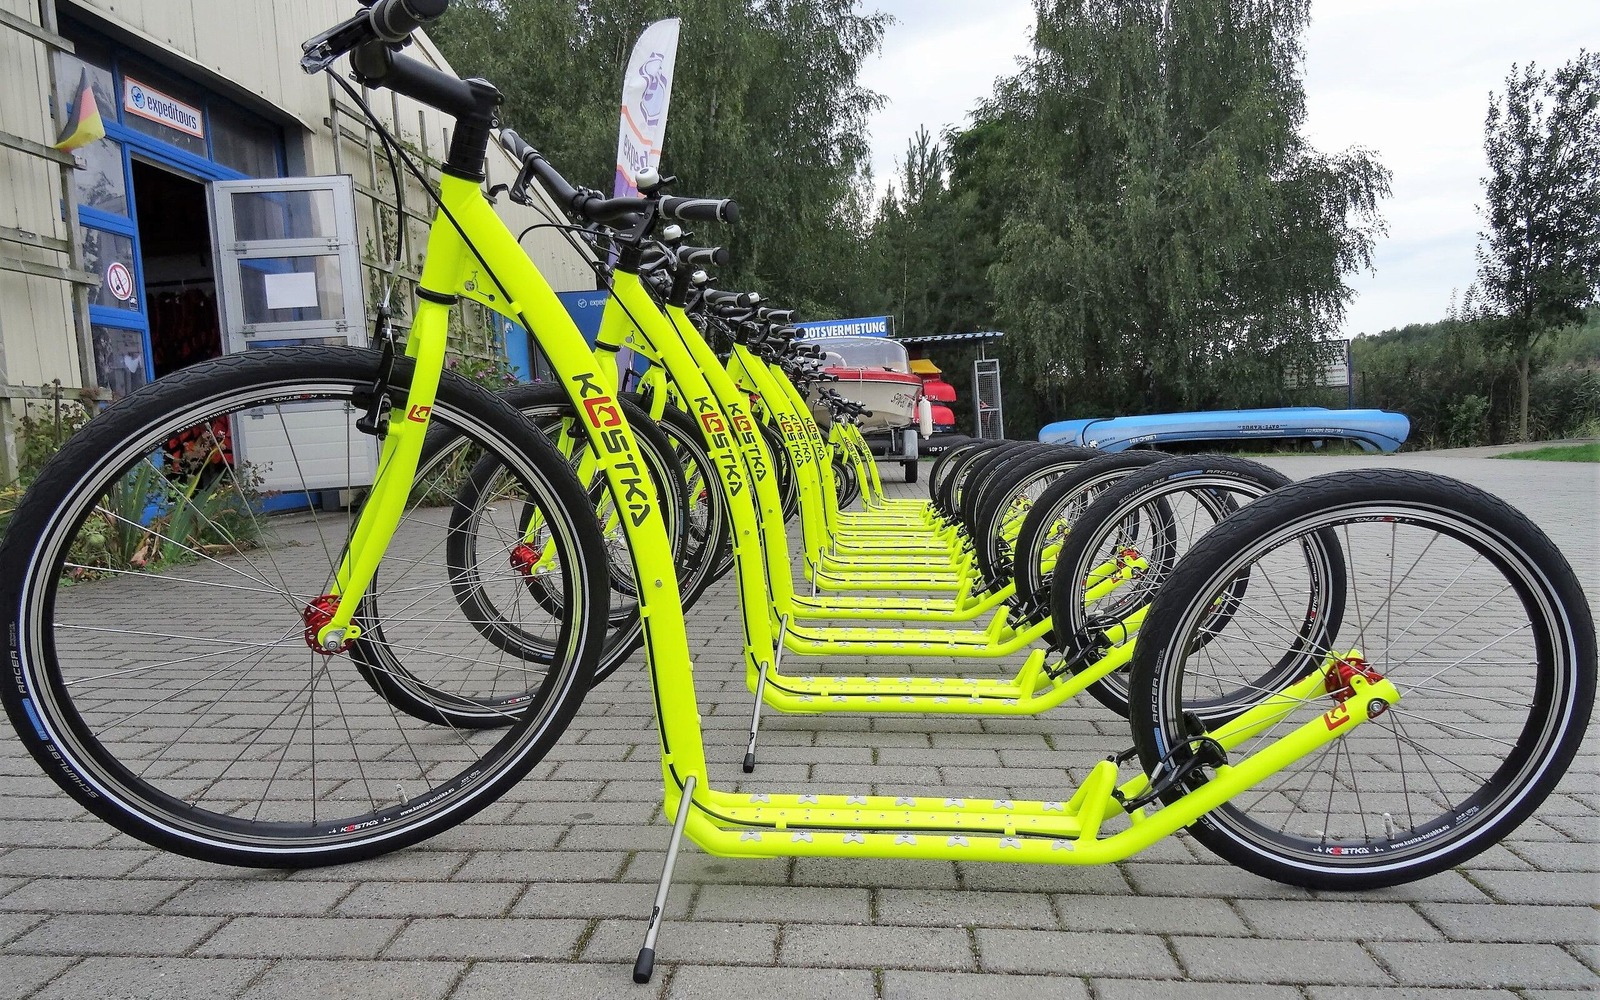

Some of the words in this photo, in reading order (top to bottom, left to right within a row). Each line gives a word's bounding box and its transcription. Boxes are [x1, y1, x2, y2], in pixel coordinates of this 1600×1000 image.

[147, 96, 197, 130] expeditours
[803, 321, 886, 338] OOTSVERMIETUNG
[572, 372, 651, 527] KOSTKA
[694, 396, 743, 497] KOSTKA
[728, 403, 767, 482] KOSTKA
[777, 412, 804, 468] KOSTKA
[804, 417, 825, 460] KOSTKA
[10, 650, 27, 694] RACER
[1151, 678, 1160, 723] RACER
[46, 744, 100, 800] SCHWALBE
[340, 819, 379, 833] KOSTKA
[1325, 845, 1371, 856] KOSTKA
